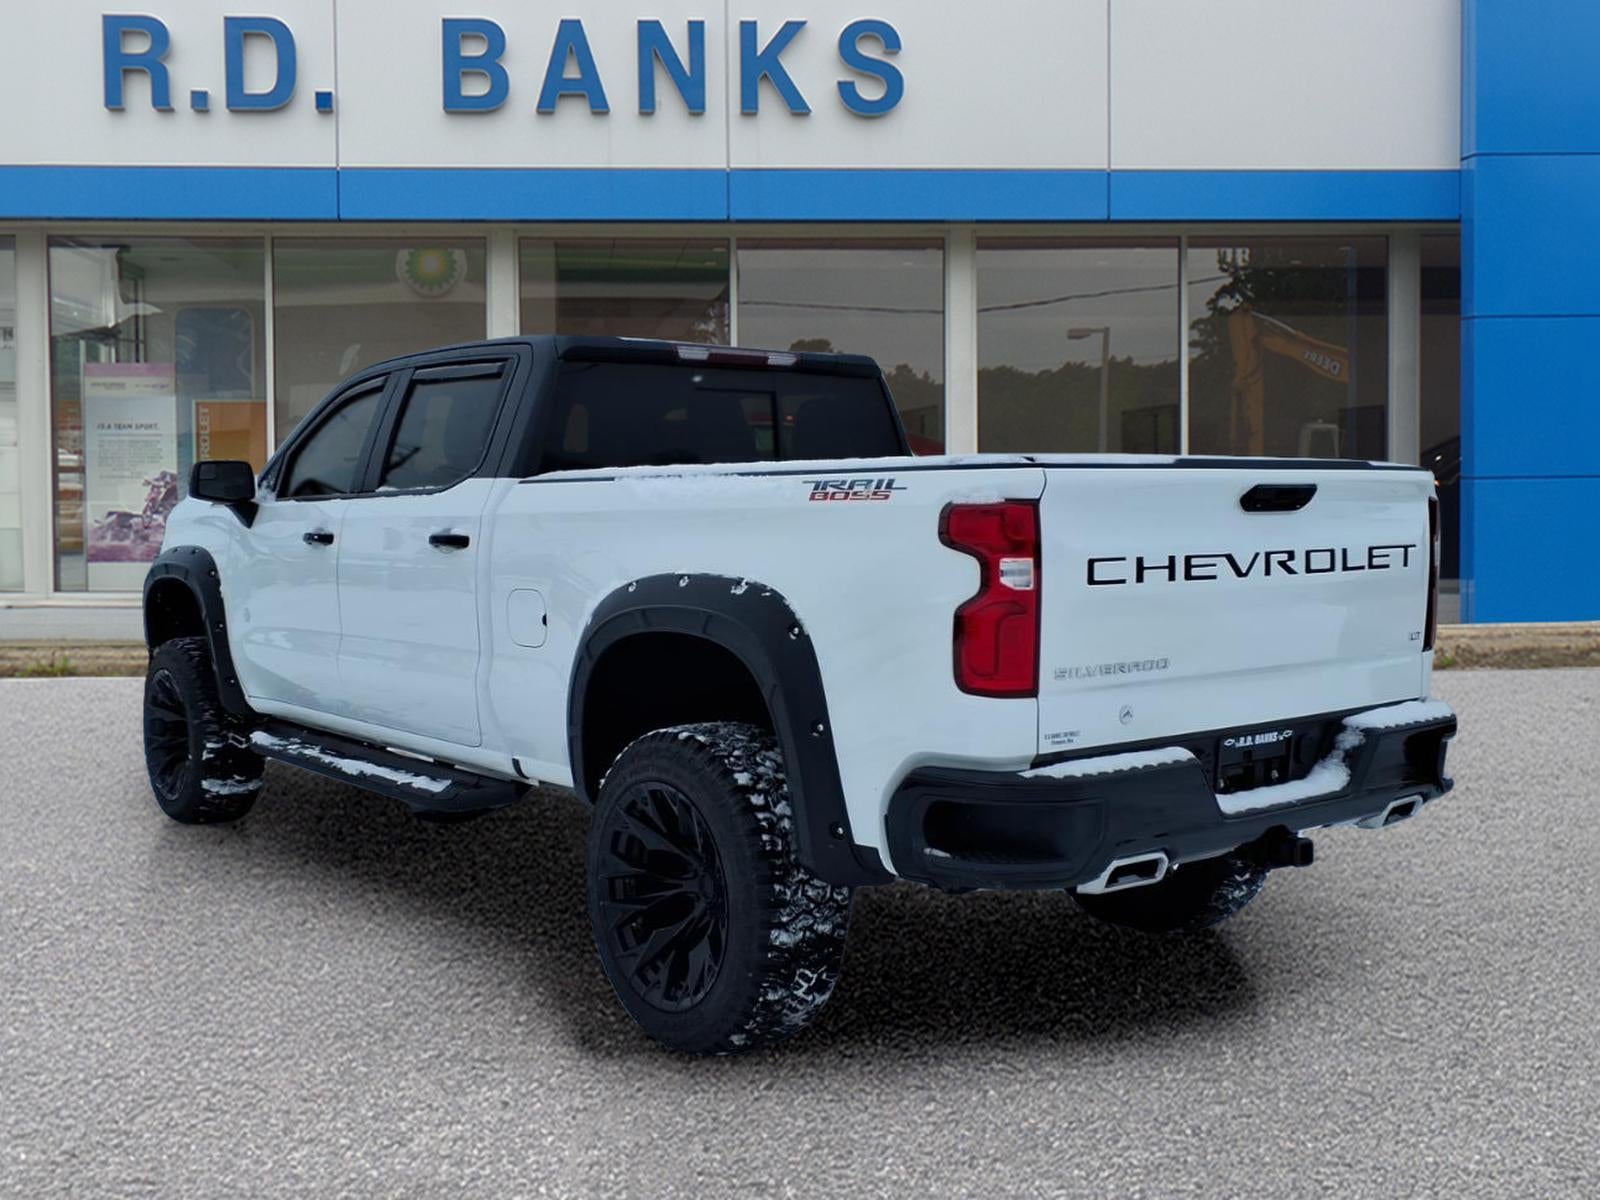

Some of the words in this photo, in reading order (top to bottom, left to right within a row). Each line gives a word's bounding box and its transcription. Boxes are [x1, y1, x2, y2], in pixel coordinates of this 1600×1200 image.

[102, 14, 335, 112] R.D.
[441, 17, 905, 117] BANKS
[114, 422, 133, 430] TEAM
[802, 478, 907, 491] TRAIL
[809, 490, 892, 502] BOSS
[1086, 544, 1417, 586] CHEVROLET
[1053, 657, 1170, 681] SILVERADO
